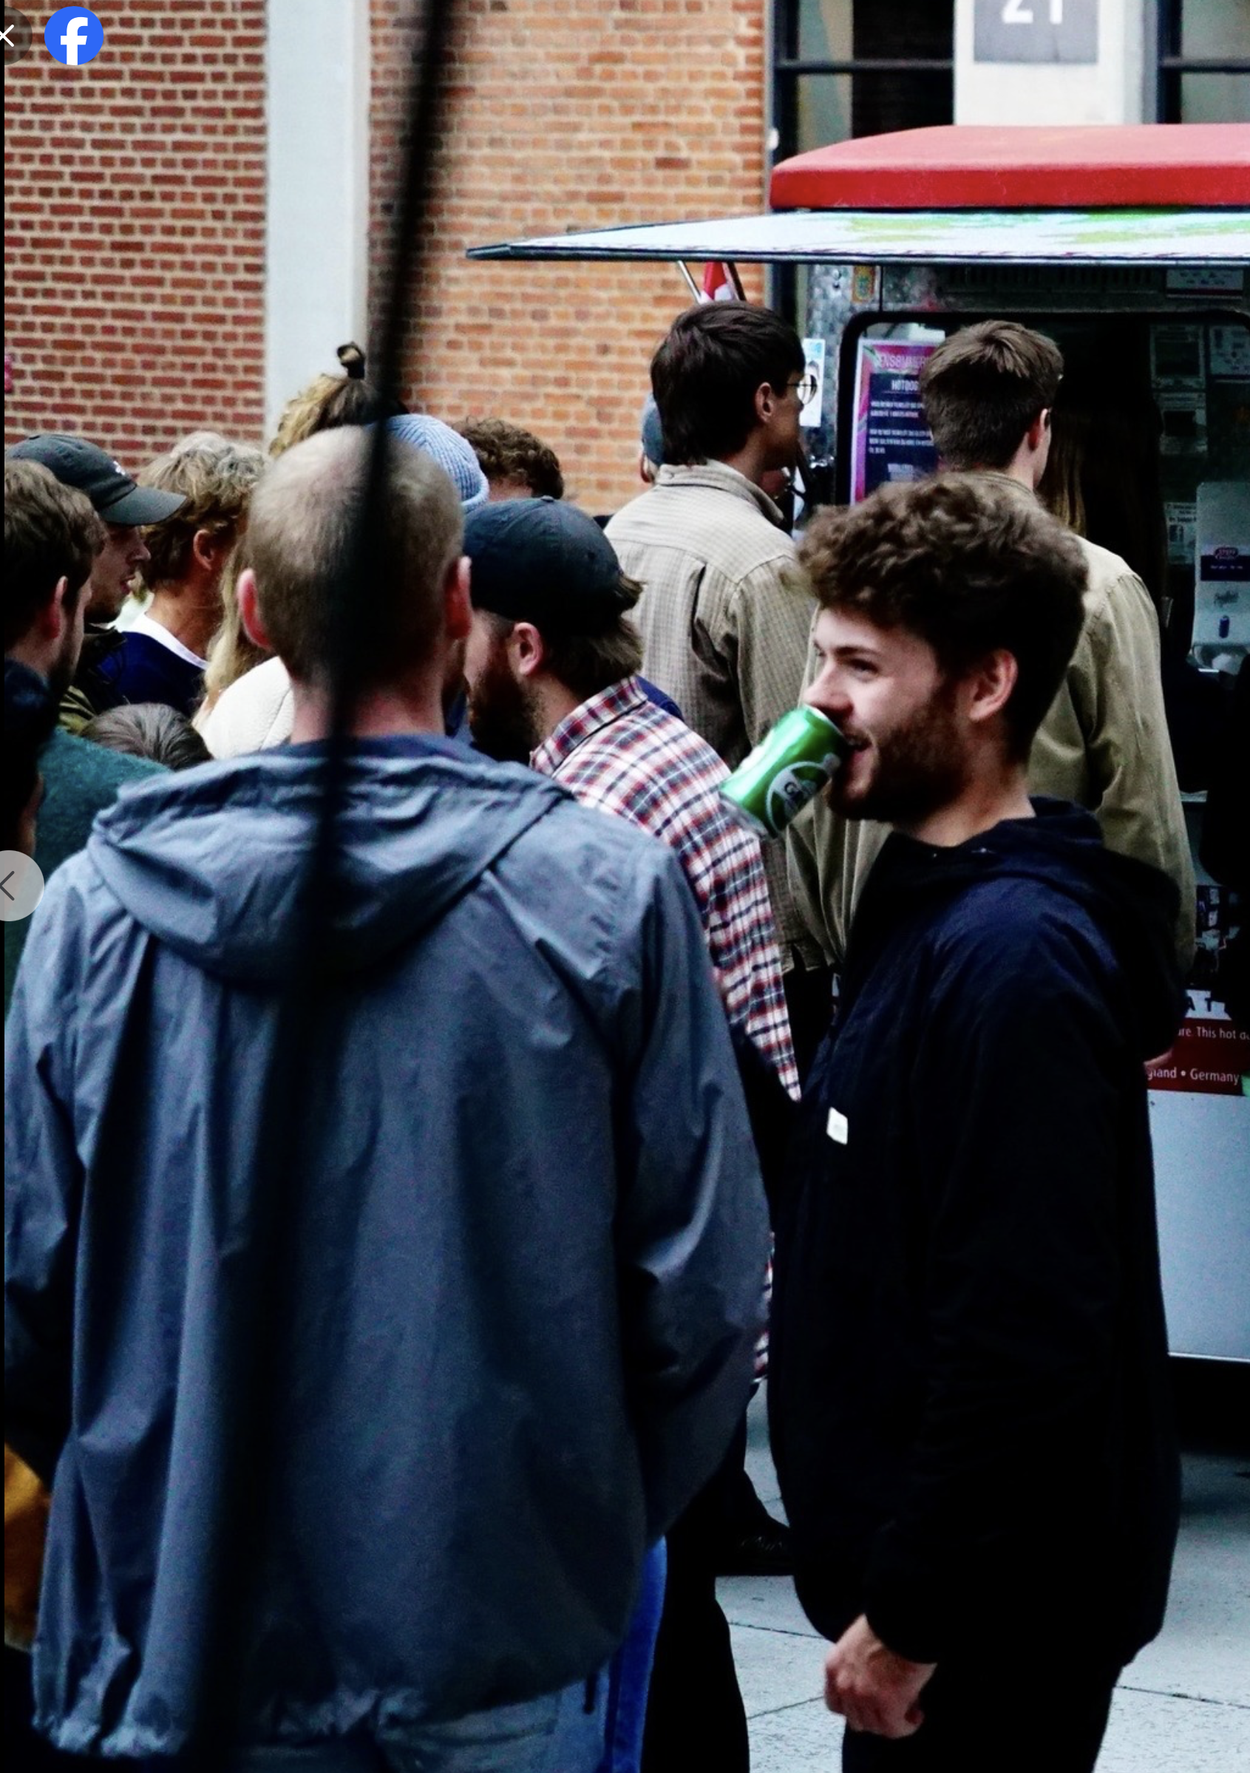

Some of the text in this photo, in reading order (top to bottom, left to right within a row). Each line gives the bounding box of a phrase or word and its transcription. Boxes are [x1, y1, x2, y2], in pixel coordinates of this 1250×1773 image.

[1196, 1026, 1217, 1039] This
[1219, 1027, 1237, 1040] hot
[1190, 1068, 1240, 1086] Germany
